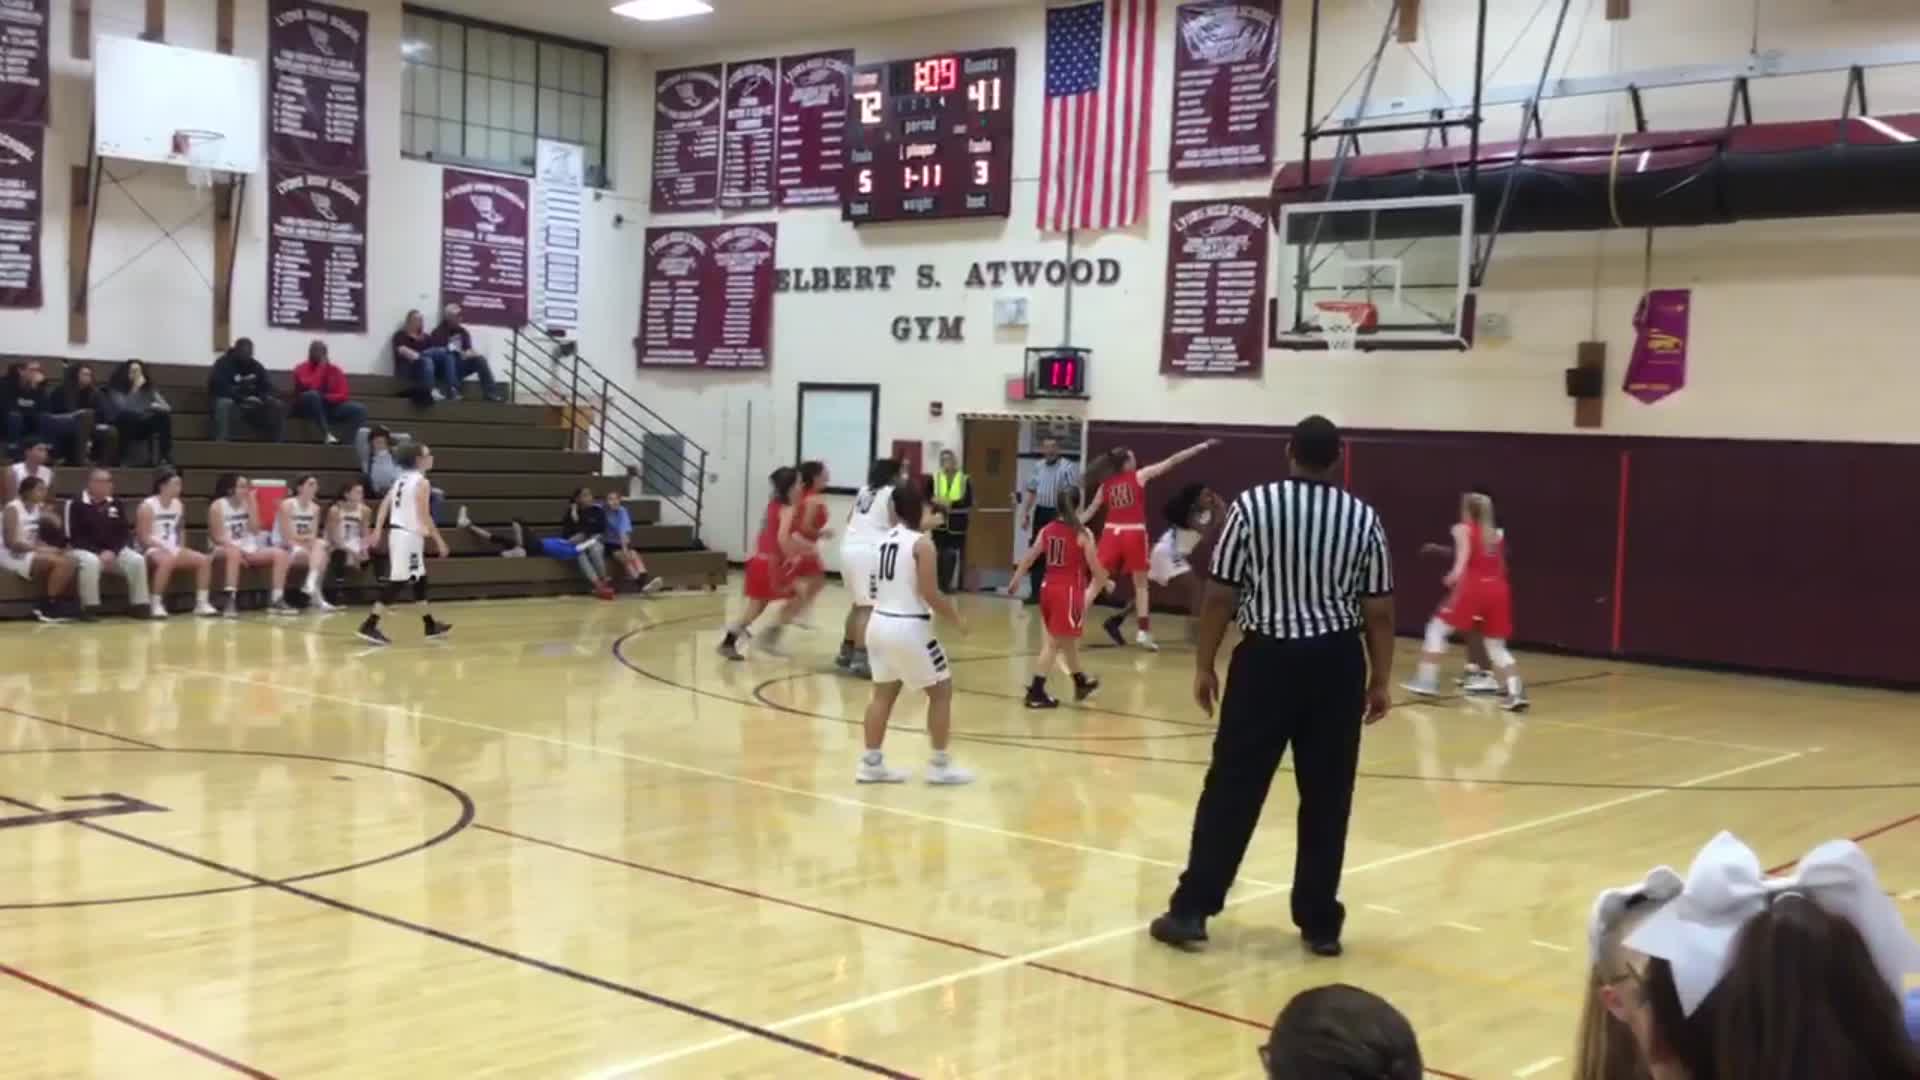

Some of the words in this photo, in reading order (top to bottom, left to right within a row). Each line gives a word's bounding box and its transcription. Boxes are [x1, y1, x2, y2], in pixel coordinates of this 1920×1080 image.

[968, 77, 1000, 112] 41
[858, 169, 872, 193] 5
[974, 160, 989, 185] 3
[774, 265, 895, 292] ELBERT
[917, 265, 941, 289] S.
[965, 259, 1122, 288] ATWOOD
[891, 316, 966, 342] GYM
[1051, 359, 1074, 388] 11
[879, 543, 899, 581] 10
[1048, 535, 1066, 567] 11
